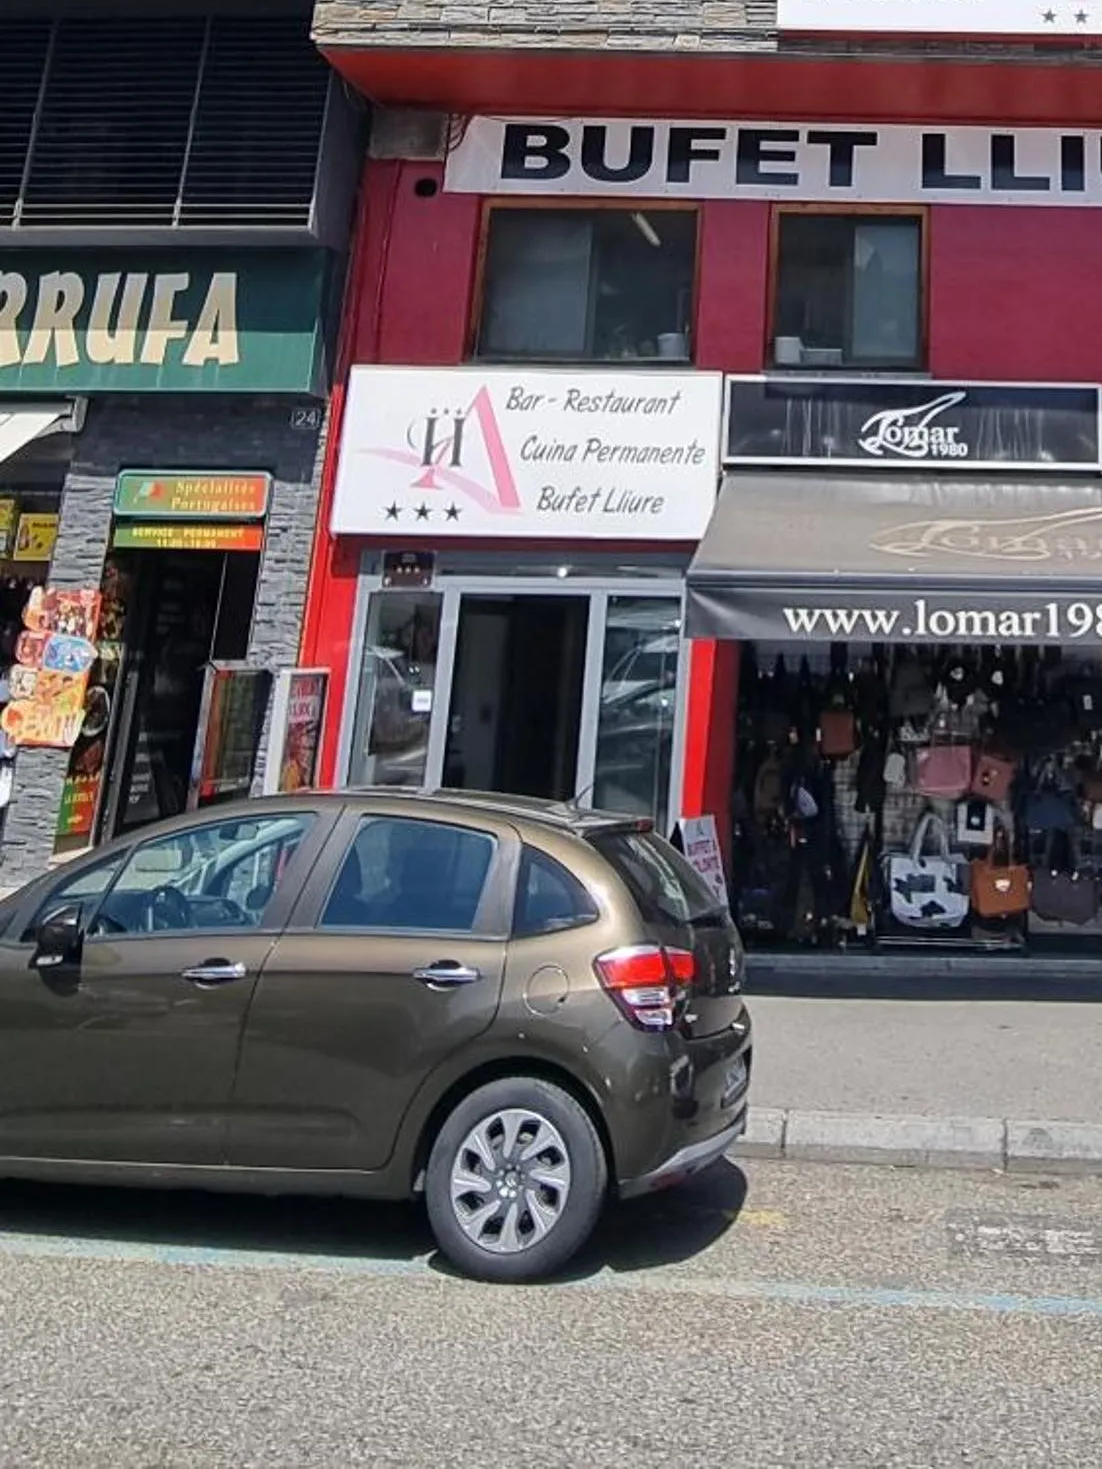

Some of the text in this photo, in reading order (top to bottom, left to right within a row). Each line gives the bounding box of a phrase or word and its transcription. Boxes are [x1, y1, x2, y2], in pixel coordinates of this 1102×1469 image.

[500, 123, 878, 188] BUFET
[506, 387, 543, 411] Bar
[564, 388, 681, 415] Restaurant
[295, 411, 317, 426] 24
[520, 436, 706, 465] Cuina Permanente
[931, 443, 968, 458] 1980
[536, 487, 665, 514] Bufet Lliure
